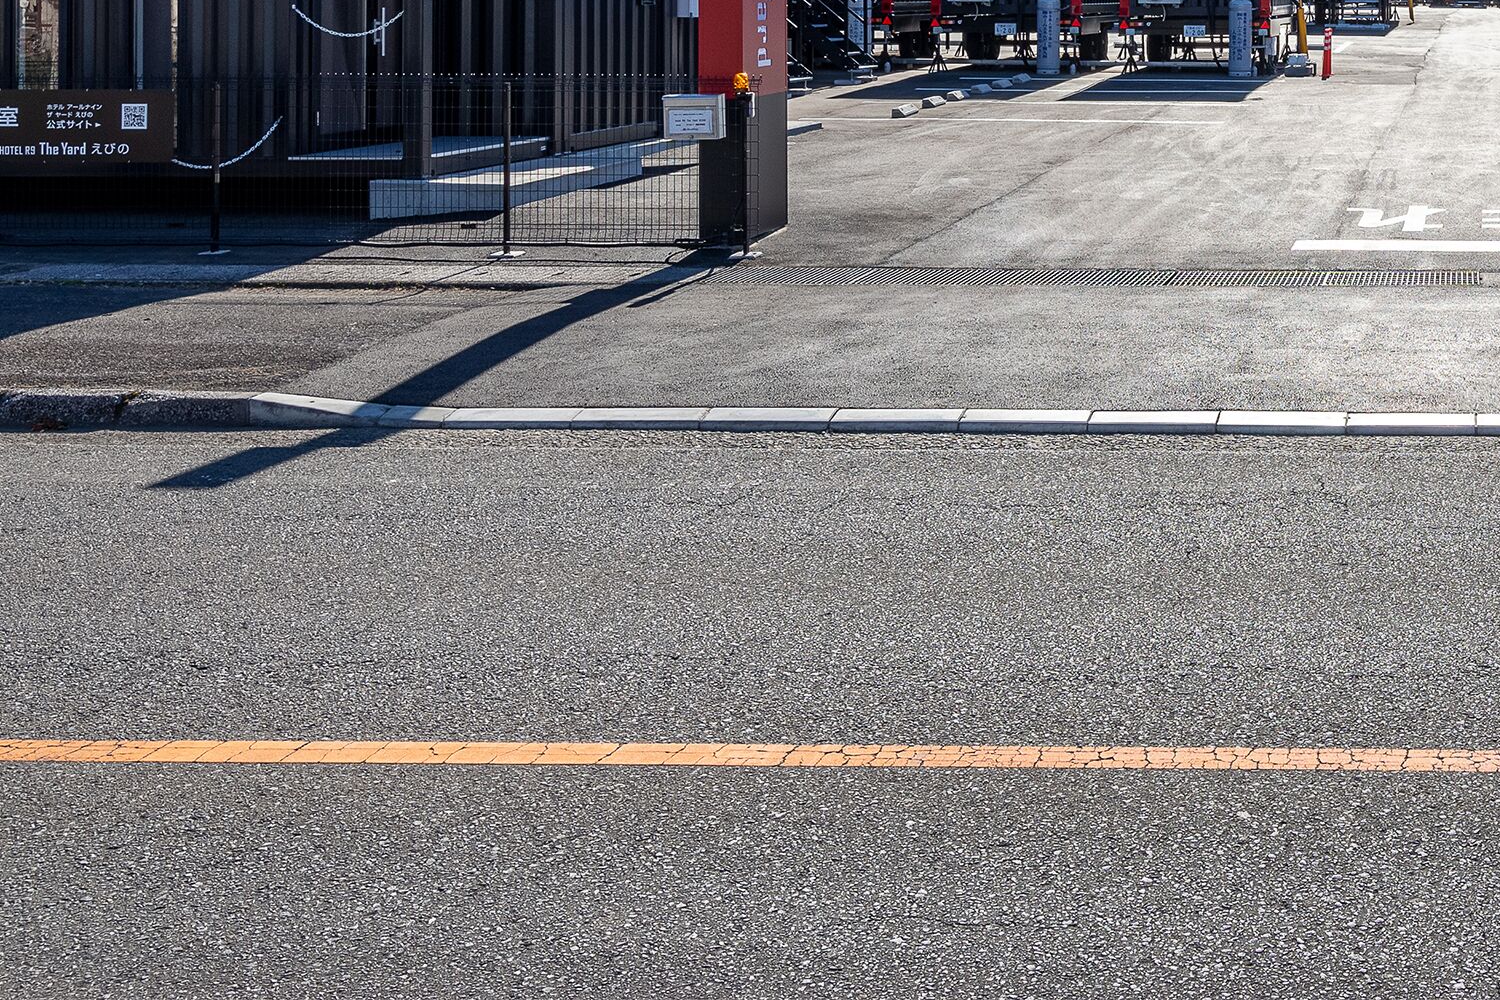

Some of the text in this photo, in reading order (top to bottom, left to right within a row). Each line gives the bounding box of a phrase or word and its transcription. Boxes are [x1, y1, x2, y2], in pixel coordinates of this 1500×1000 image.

[0, 106, 19, 127] 室
[46, 119, 93, 129] 公式サイト
[0, 142, 130, 155] HOTEL R9 The Yard えびの
